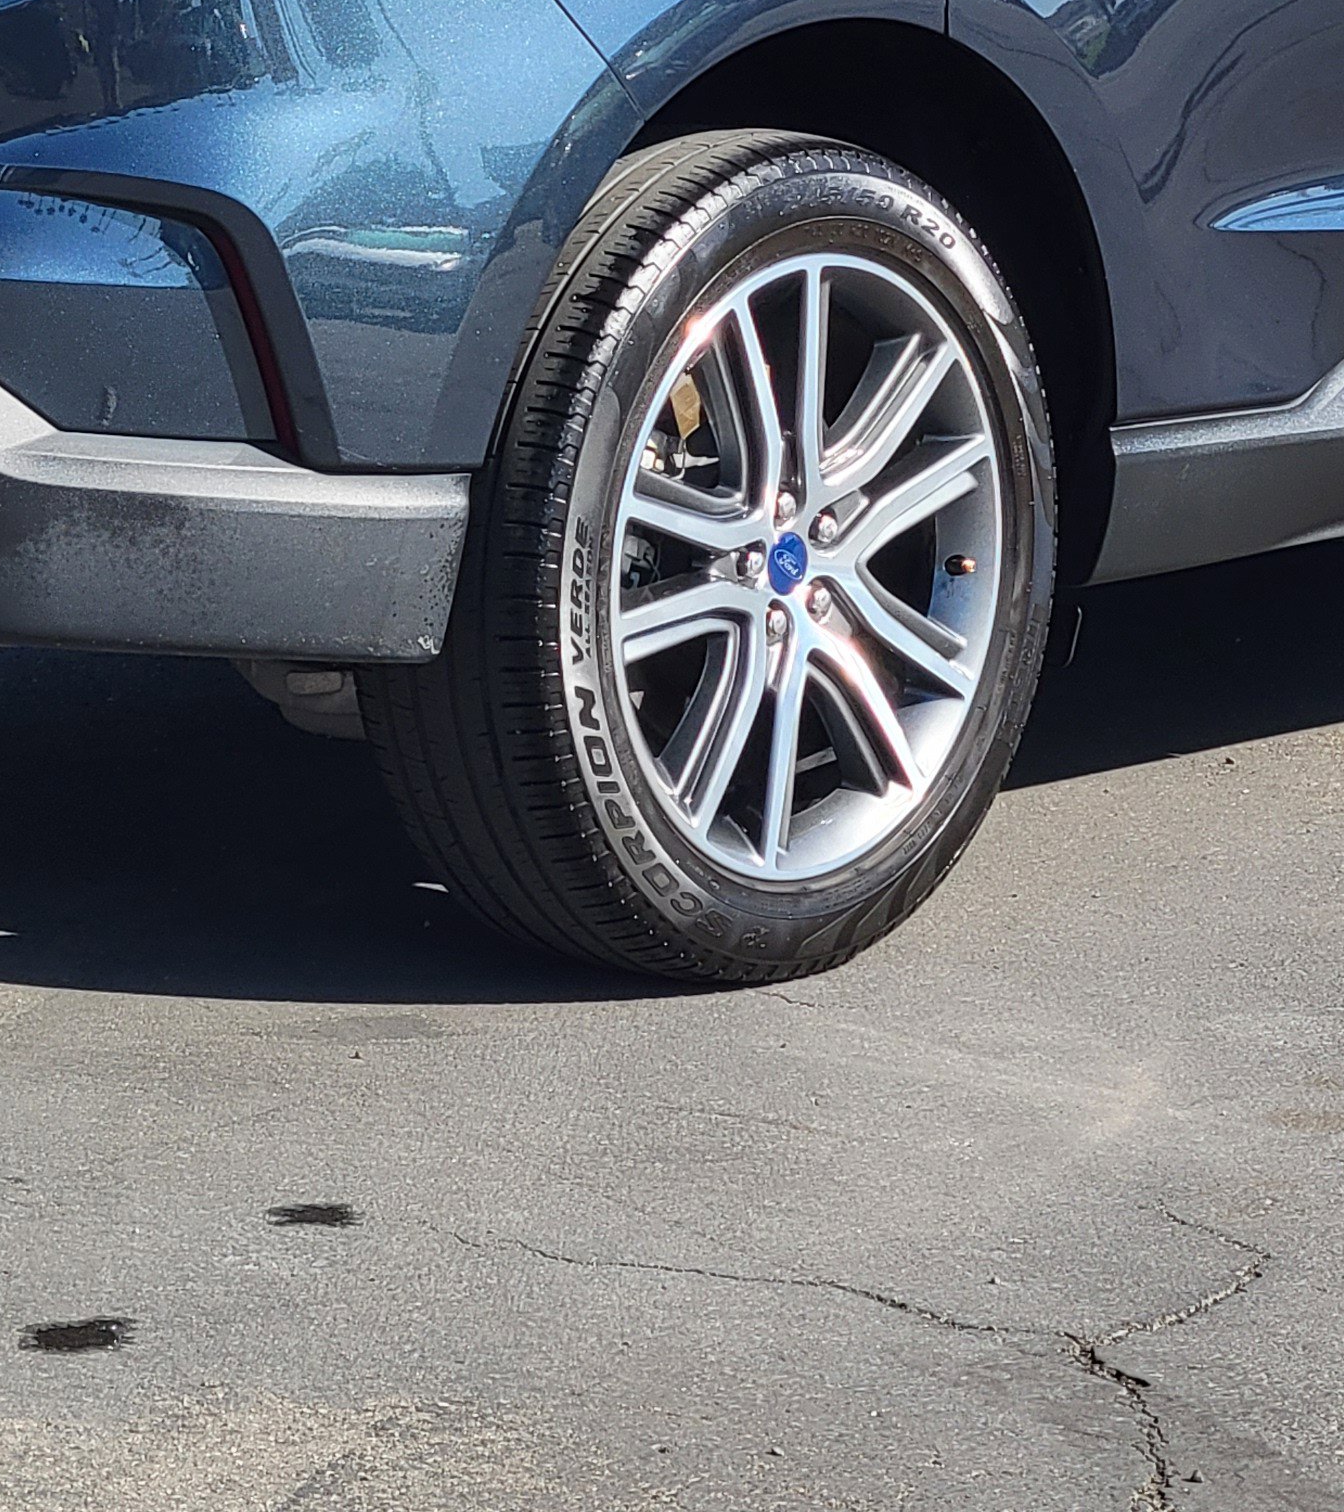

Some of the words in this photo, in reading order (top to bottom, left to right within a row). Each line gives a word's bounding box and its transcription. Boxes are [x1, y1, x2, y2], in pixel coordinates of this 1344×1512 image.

[899, 202, 957, 250] R20
[569, 516, 589, 666] VERDE
[778, 553, 800, 576] Ford
[573, 684, 734, 938] SCORPION
